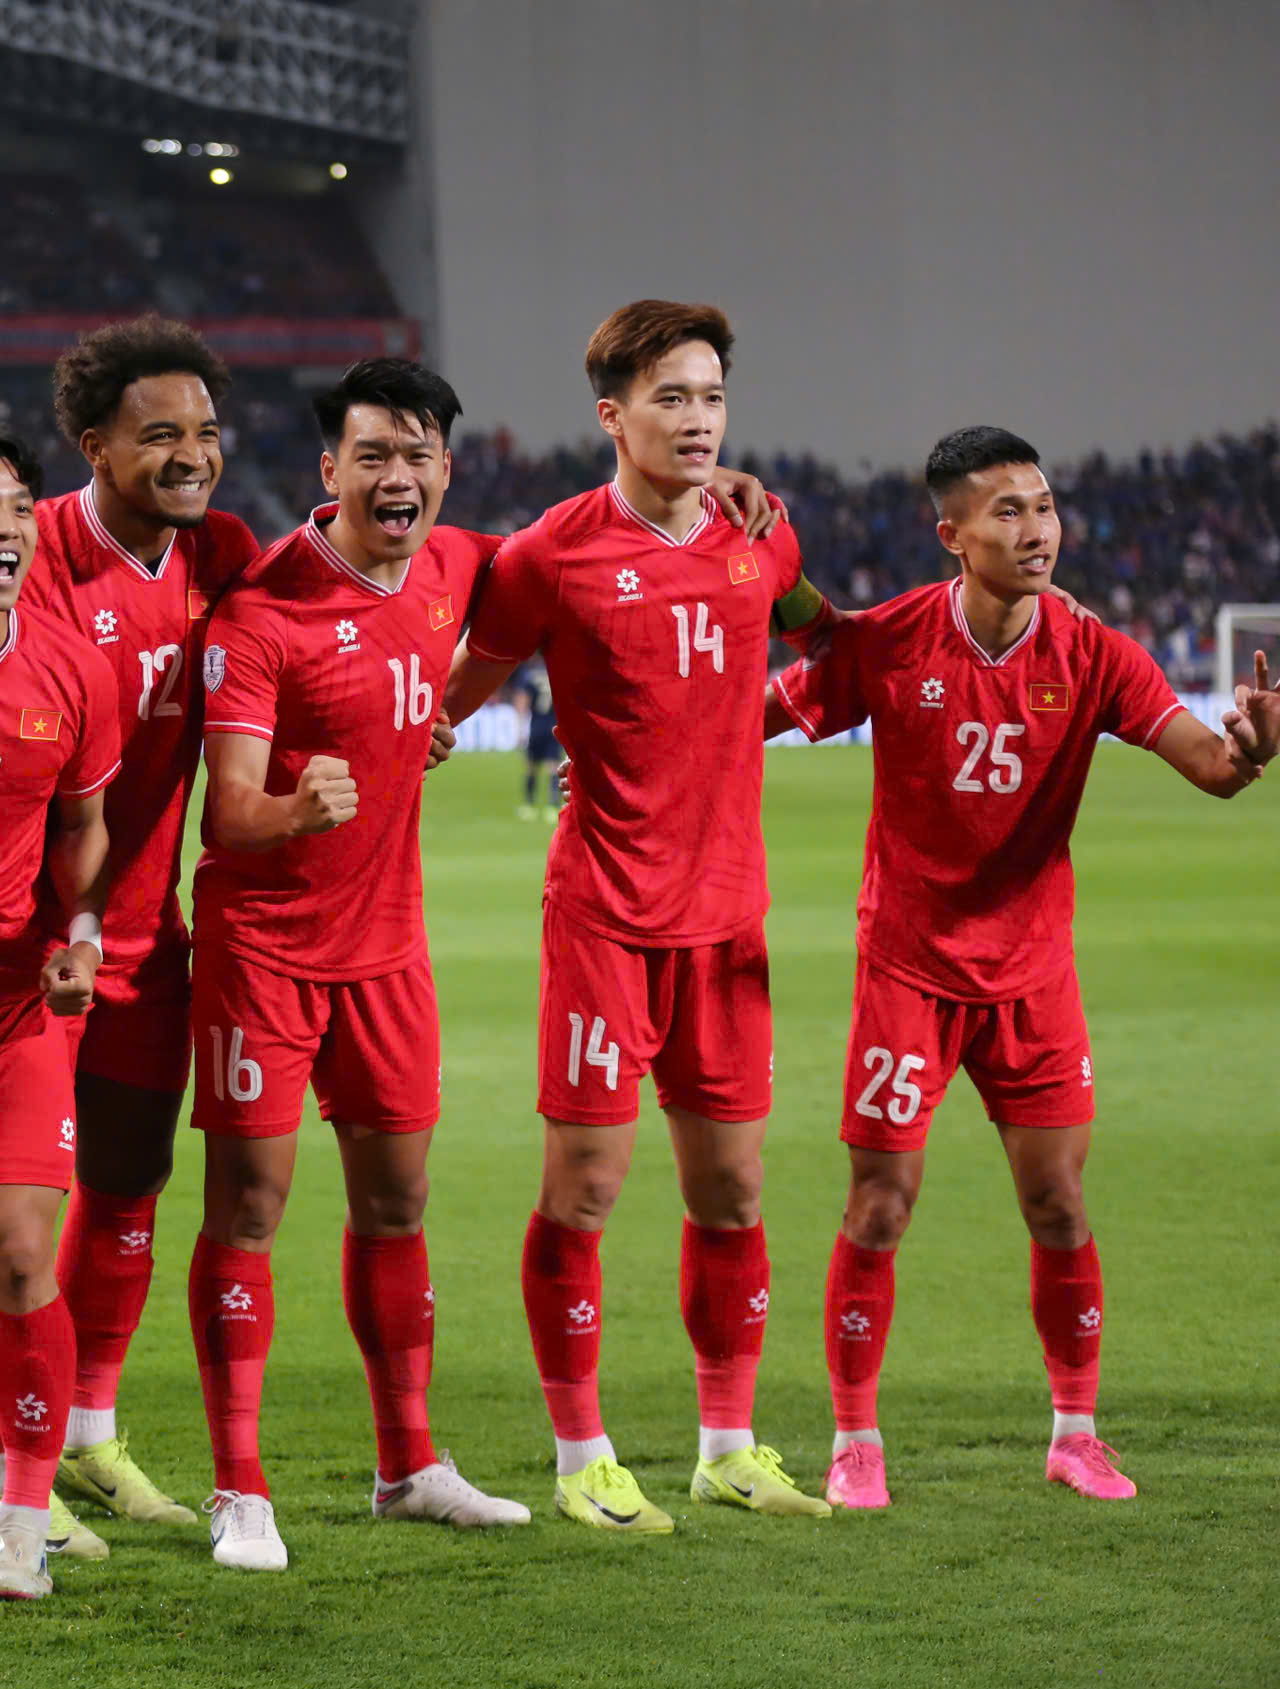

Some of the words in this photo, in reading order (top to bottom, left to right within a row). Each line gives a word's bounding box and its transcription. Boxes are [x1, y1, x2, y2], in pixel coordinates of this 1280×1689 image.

[672, 602, 724, 678] 14
[138, 644, 183, 720] 12
[387, 653, 433, 731] 16
[952, 721, 1026, 794] 25
[209, 1025, 263, 1102] 16
[568, 1012, 620, 1090] 14
[855, 1047, 926, 1124] 25
